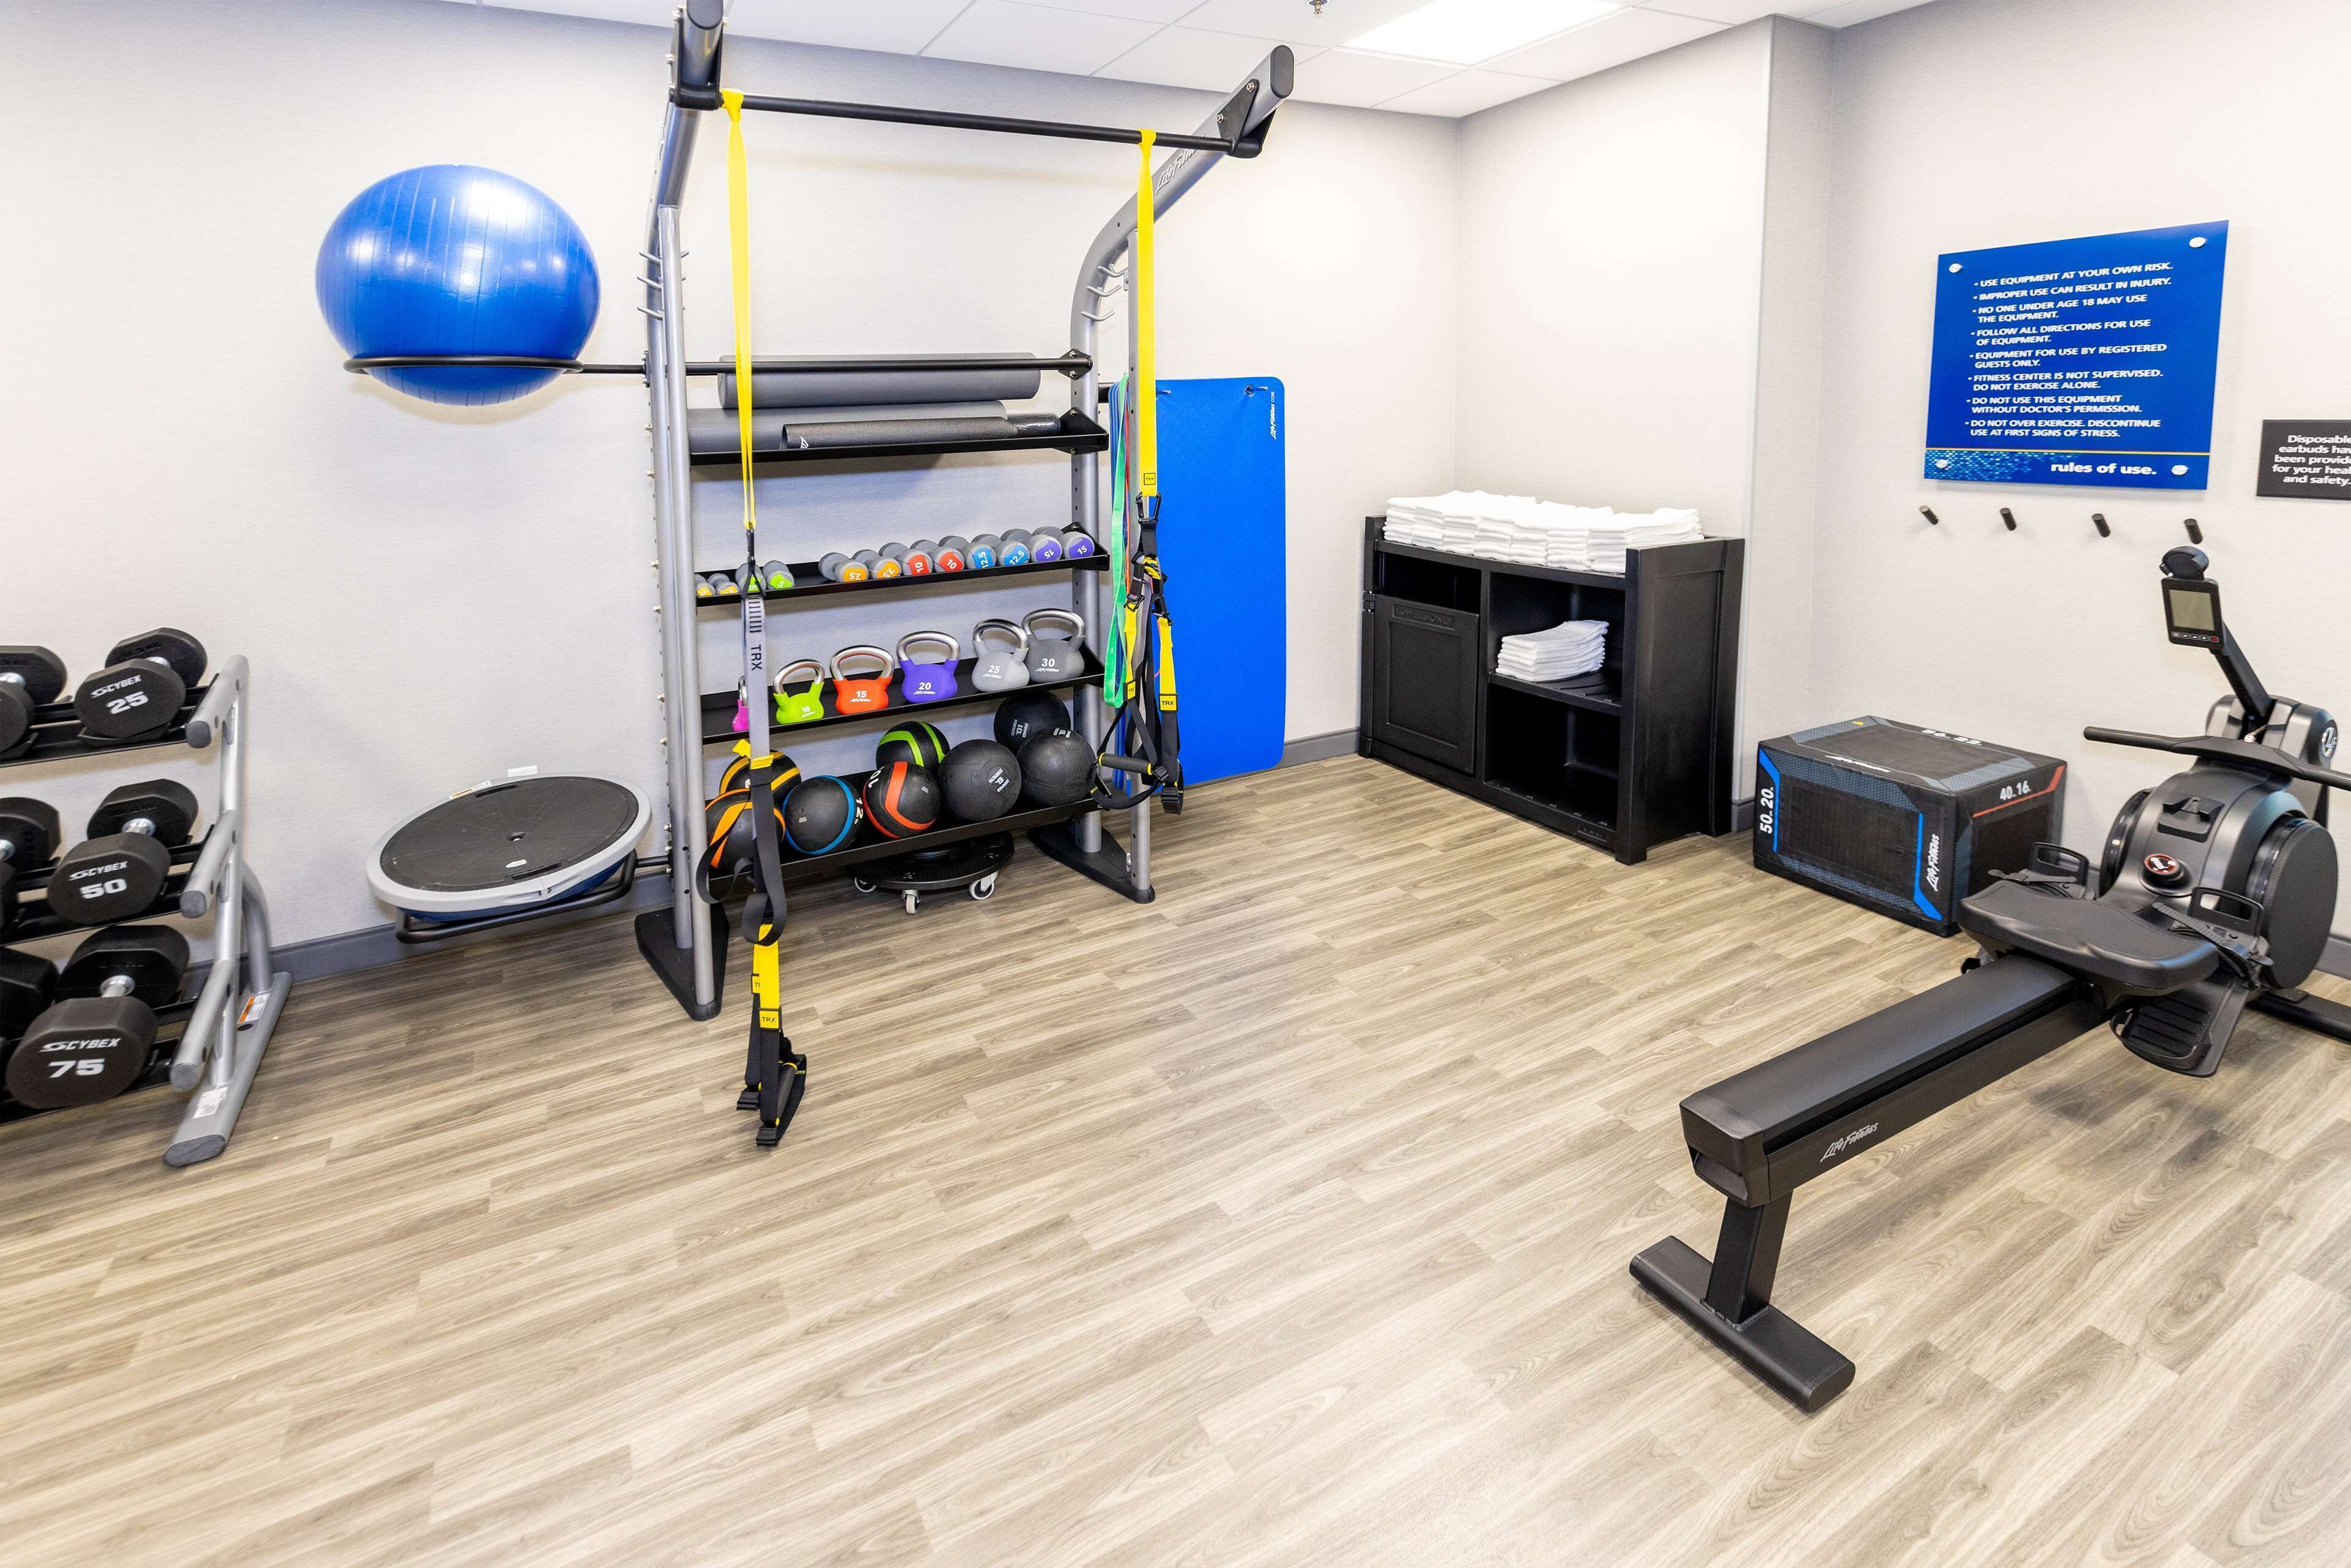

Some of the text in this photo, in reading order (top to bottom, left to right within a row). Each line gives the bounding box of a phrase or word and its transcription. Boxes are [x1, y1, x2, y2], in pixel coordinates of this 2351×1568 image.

[1980, 262, 2173, 287] USE EQUIPMENT AT YOUR OWN RISK.
[1979, 290, 2028, 301] IMPROPER
[2030, 288, 2049, 296] USE
[2050, 286, 2074, 294] CAN
[2075, 282, 2115, 293] RESULT
[2129, 277, 2172, 288] INJURY.
[1995, 304, 2017, 313] ONE
[2019, 301, 2055, 311] UNDER
[2056, 299, 2079, 308] AGE
[2096, 296, 2124, 305] MAY
[2126, 294, 2148, 303] USE
[1998, 310, 2059, 322] EQUIPMENT.
[1976, 328, 2019, 337] FOLLOW
[2040, 322, 2102, 333] DIRECTIONS
[2129, 319, 2151, 328] USE
[1991, 335, 2052, 345] EQUIPMENT.
[1975, 350, 2034, 360] EQUIPMENT
[2098, 343, 2167, 354] REGISTERED
[1974, 360, 2011, 369] GUESTS
[2012, 372, 2052, 381] CENTER
[2092, 369, 2164, 378] SUPERVISED.
[2058, 395, 2123, 404] EQUIPMENT
[2279, 445, 2329, 454] earbuds
[2308, 456, 2351, 465] provid
[2050, 462, 2157, 475] rules of use.
[2310, 476, 2351, 487] safety.
[1044, 549, 1055, 559] 15
[1076, 544, 1088, 555] 15
[948, 558, 958, 569] 10
[1009, 549, 1026, 566] 12.5
[914, 561, 923, 573] 10
[751, 644, 762, 671] TRX
[1041, 658, 1055, 668] 30
[989, 665, 1000, 673] 25
[919, 682, 931, 691] 20
[107, 691, 149, 715] 25
[2000, 780, 2030, 801] 40 16
[1760, 788, 1774, 834] 50 20
[80, 879, 127, 899] 50
[48, 1058, 105, 1079] 75
